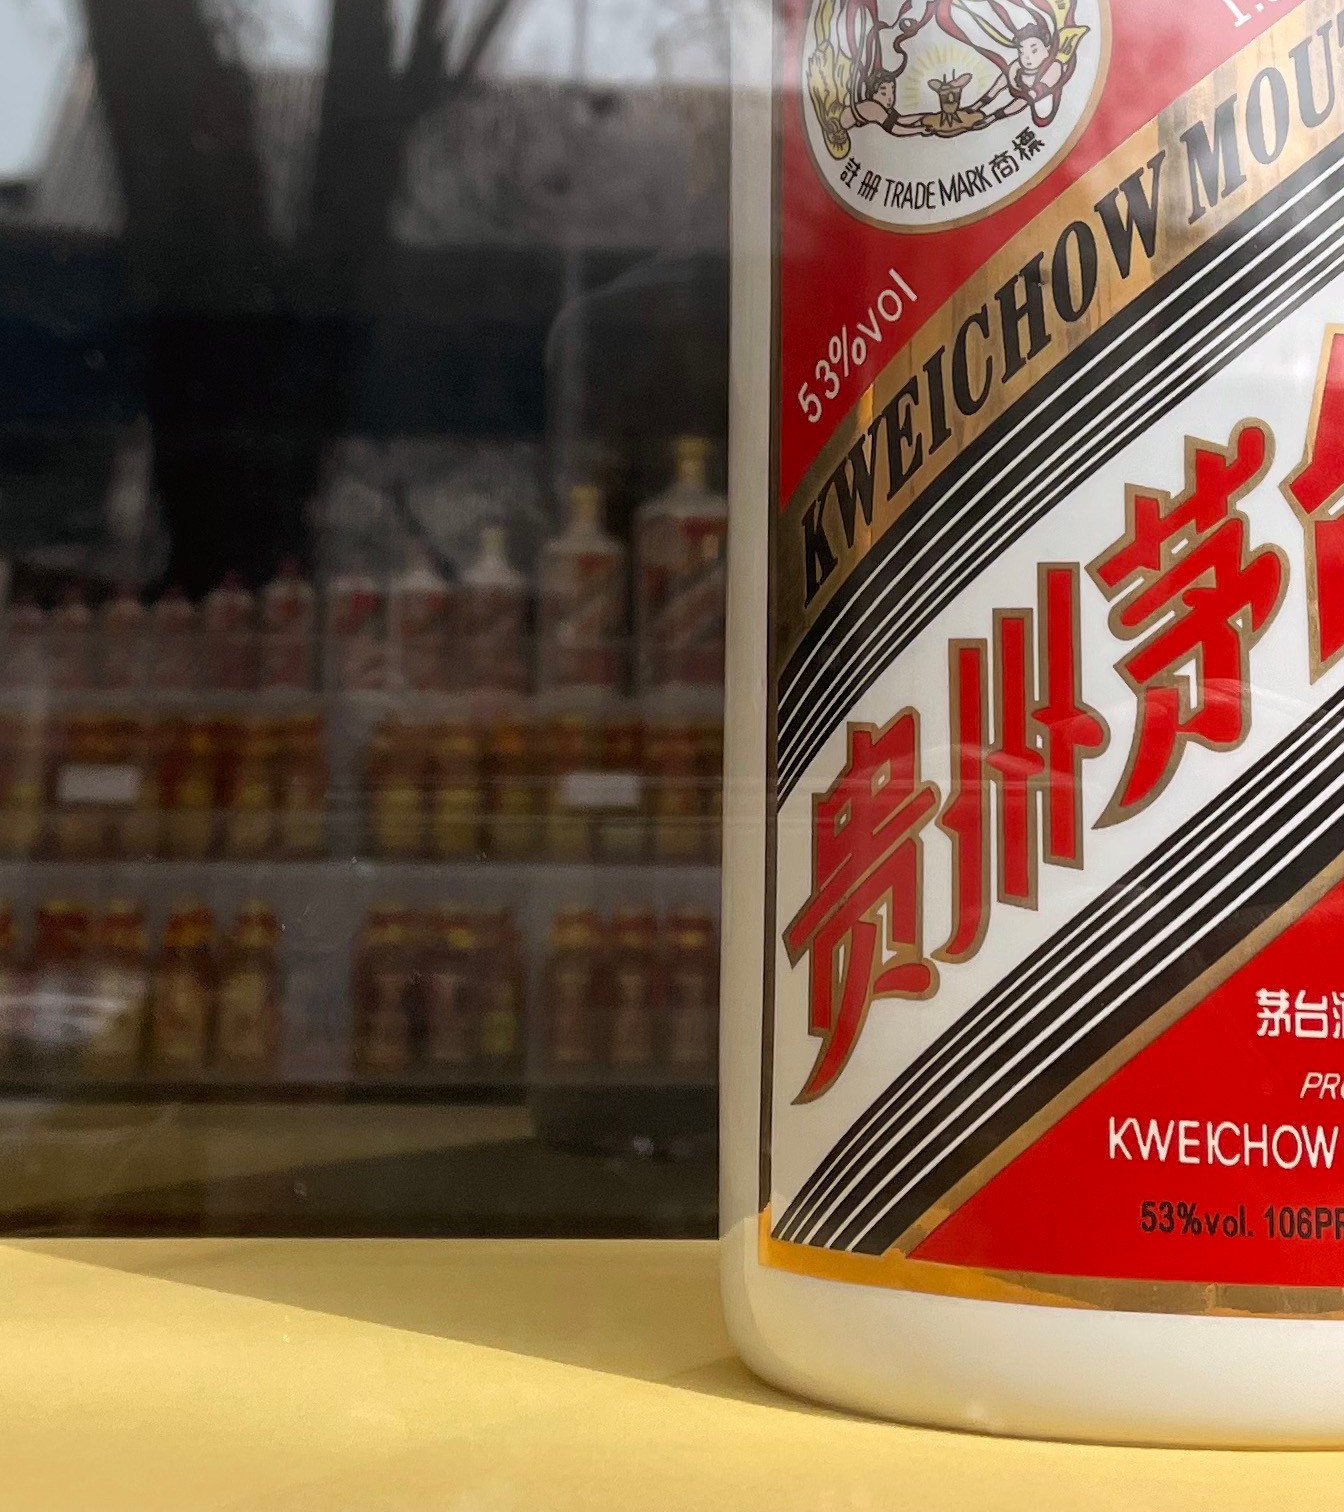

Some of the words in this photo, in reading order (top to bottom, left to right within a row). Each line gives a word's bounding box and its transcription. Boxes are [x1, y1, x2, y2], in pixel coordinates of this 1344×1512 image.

[883, 178, 936, 210] TRADE
[939, 165, 993, 207] MARK
[798, 268, 918, 423] 53%vol
[801, 150, 1170, 608] KWEICHOW
[1107, 1116, 1340, 1170] KWEICHOW
